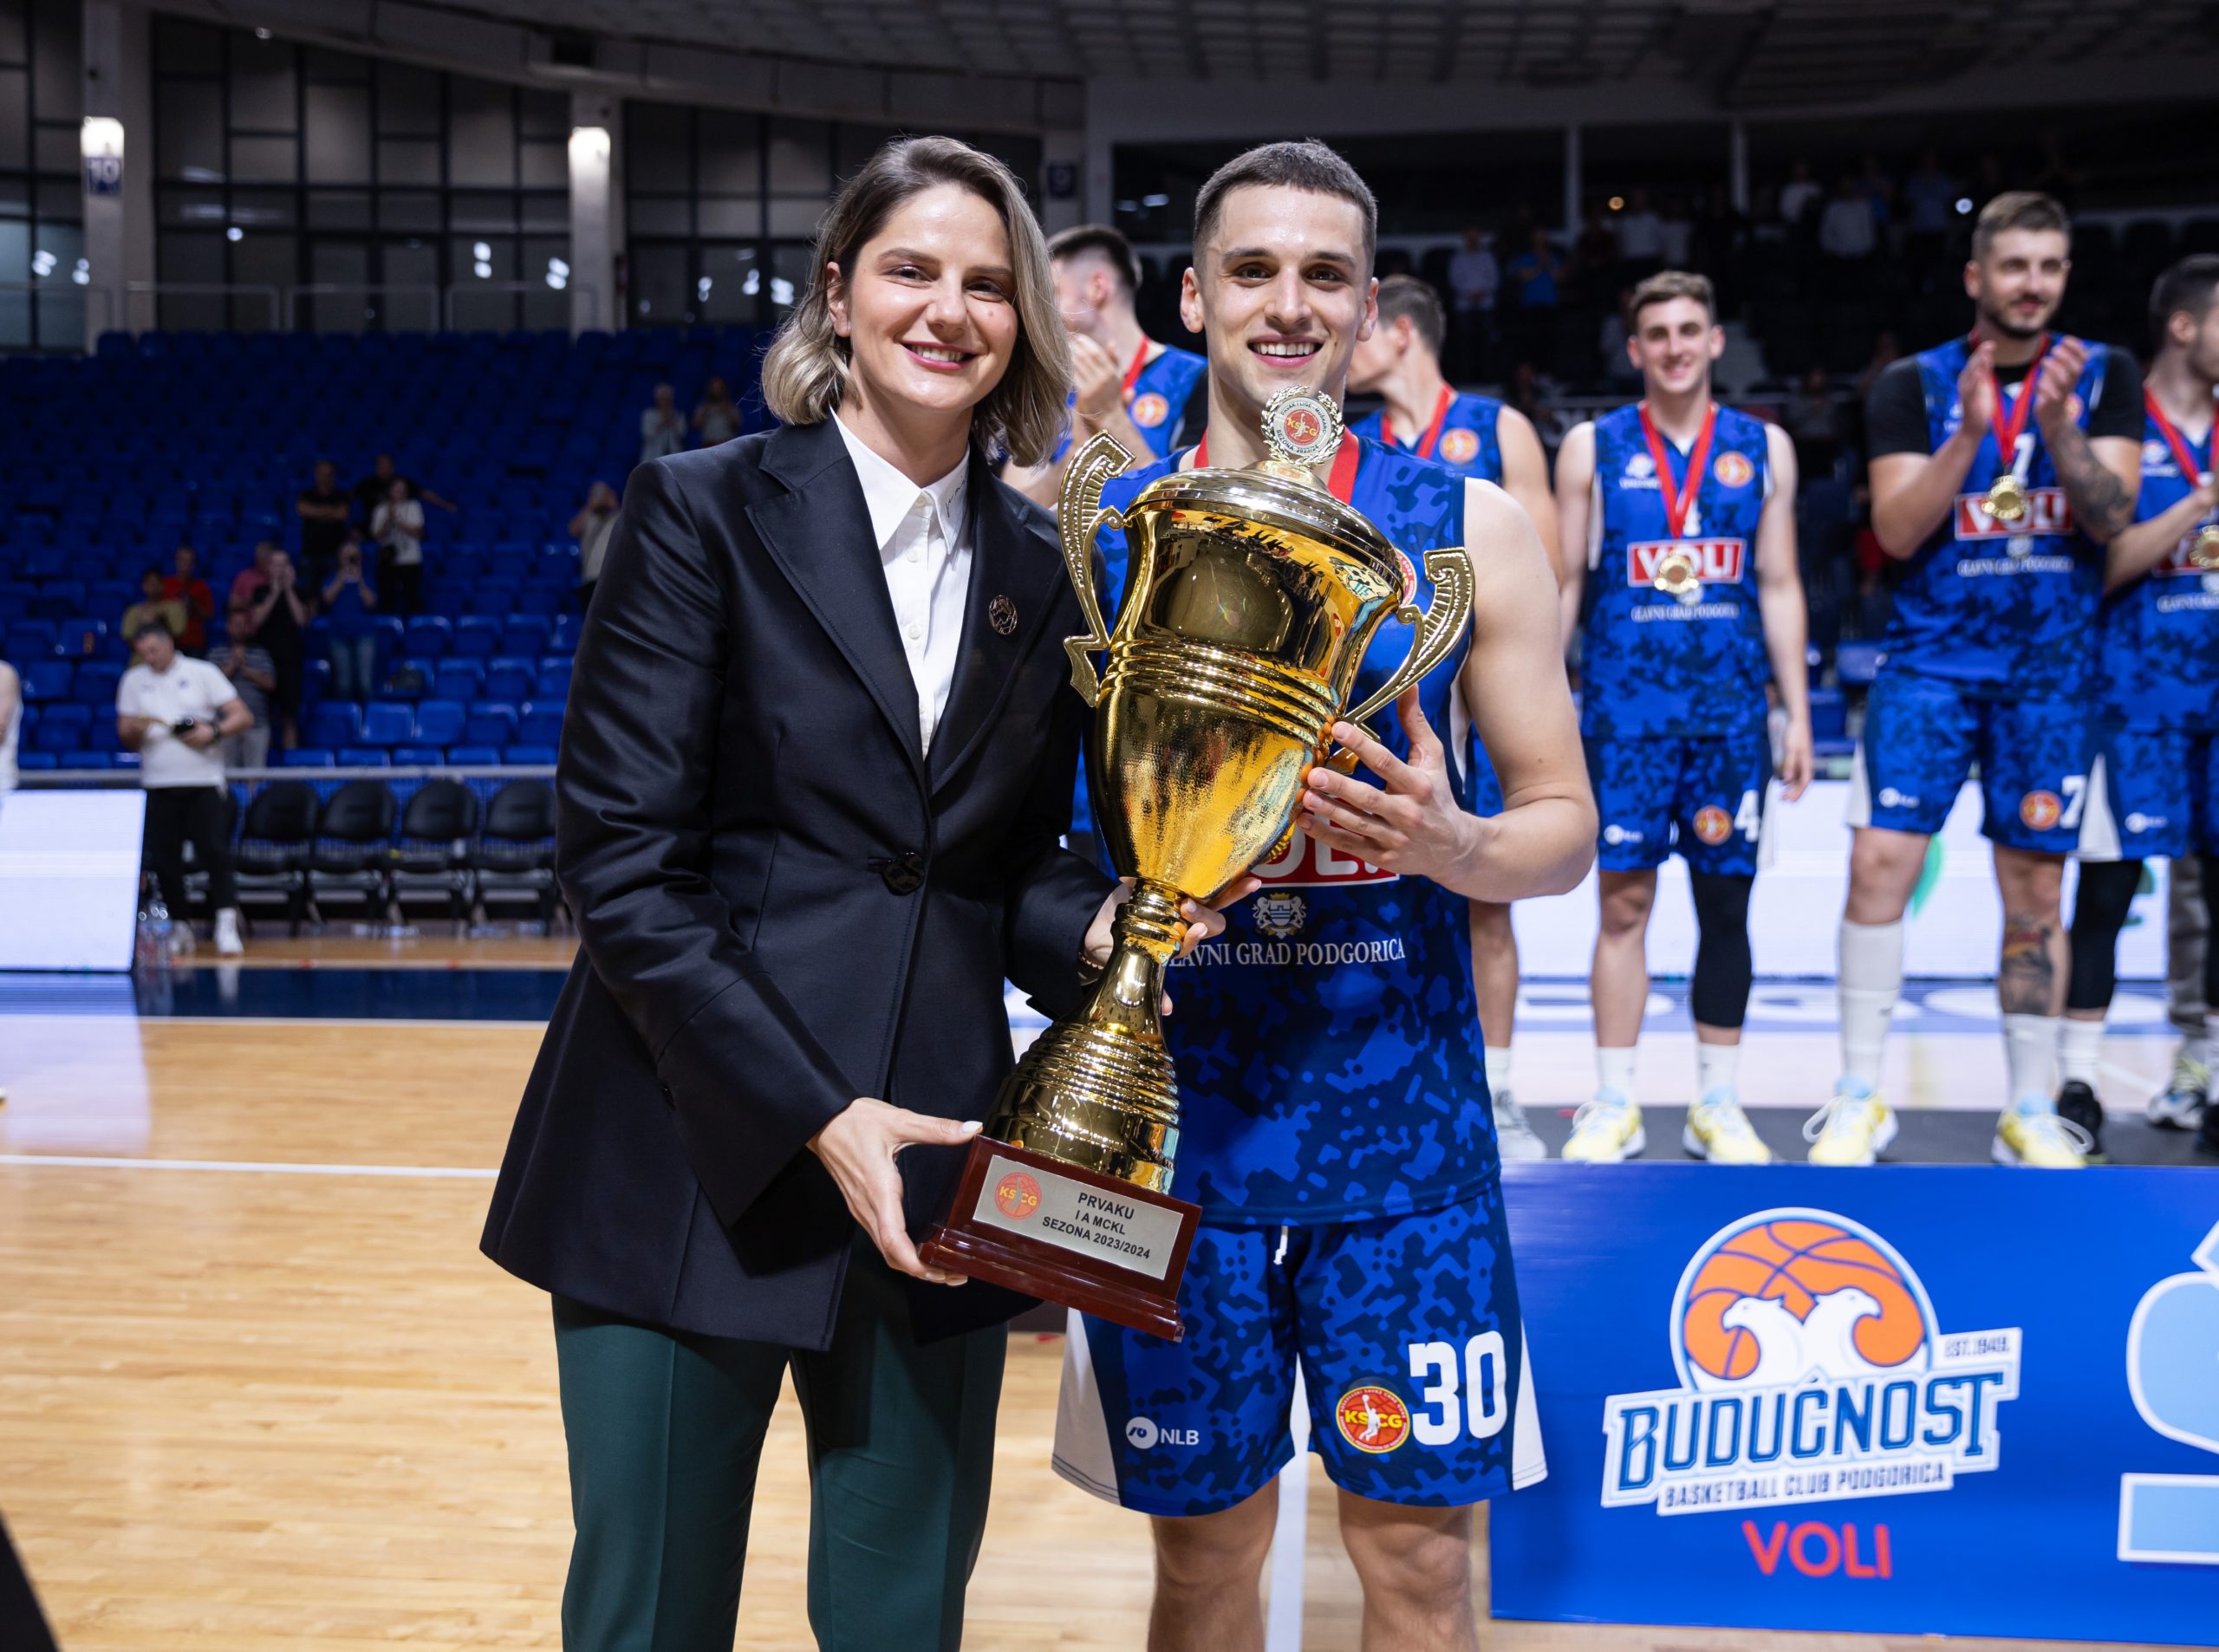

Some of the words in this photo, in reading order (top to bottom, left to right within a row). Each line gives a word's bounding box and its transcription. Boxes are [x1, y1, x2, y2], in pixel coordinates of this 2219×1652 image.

[1276, 429, 1294, 452] SEZONA
[1734, 790, 1760, 842] 4
[2060, 775, 2086, 829] 7
[1236, 942, 1292, 966] GRAD
[1296, 938, 1406, 966] PODGORICA
[999, 1186, 1038, 1206] KSCG
[1077, 1192, 1135, 1220] PRVAKU
[1042, 1216, 1090, 1241] SEZONA
[1093, 1232, 1151, 1259] 2023/2024
[1075, 1210, 1080, 1220] I
[1080, 1213, 1090, 1224] A
[1092, 1215, 1126, 1235] MCKL
[1408, 1330, 1507, 1446] 30
[1344, 1409, 1402, 1429] KSCG
[1617, 1371, 2004, 1491] BUDUĆNOST
[1160, 1428, 1200, 1446] NLB
[1664, 1476, 1778, 1509] BASKETBALL
[1786, 1472, 1829, 1496] CLUB
[1837, 1462, 1945, 1493] PODGORICA
[1741, 1519, 1893, 1579] VOLI
